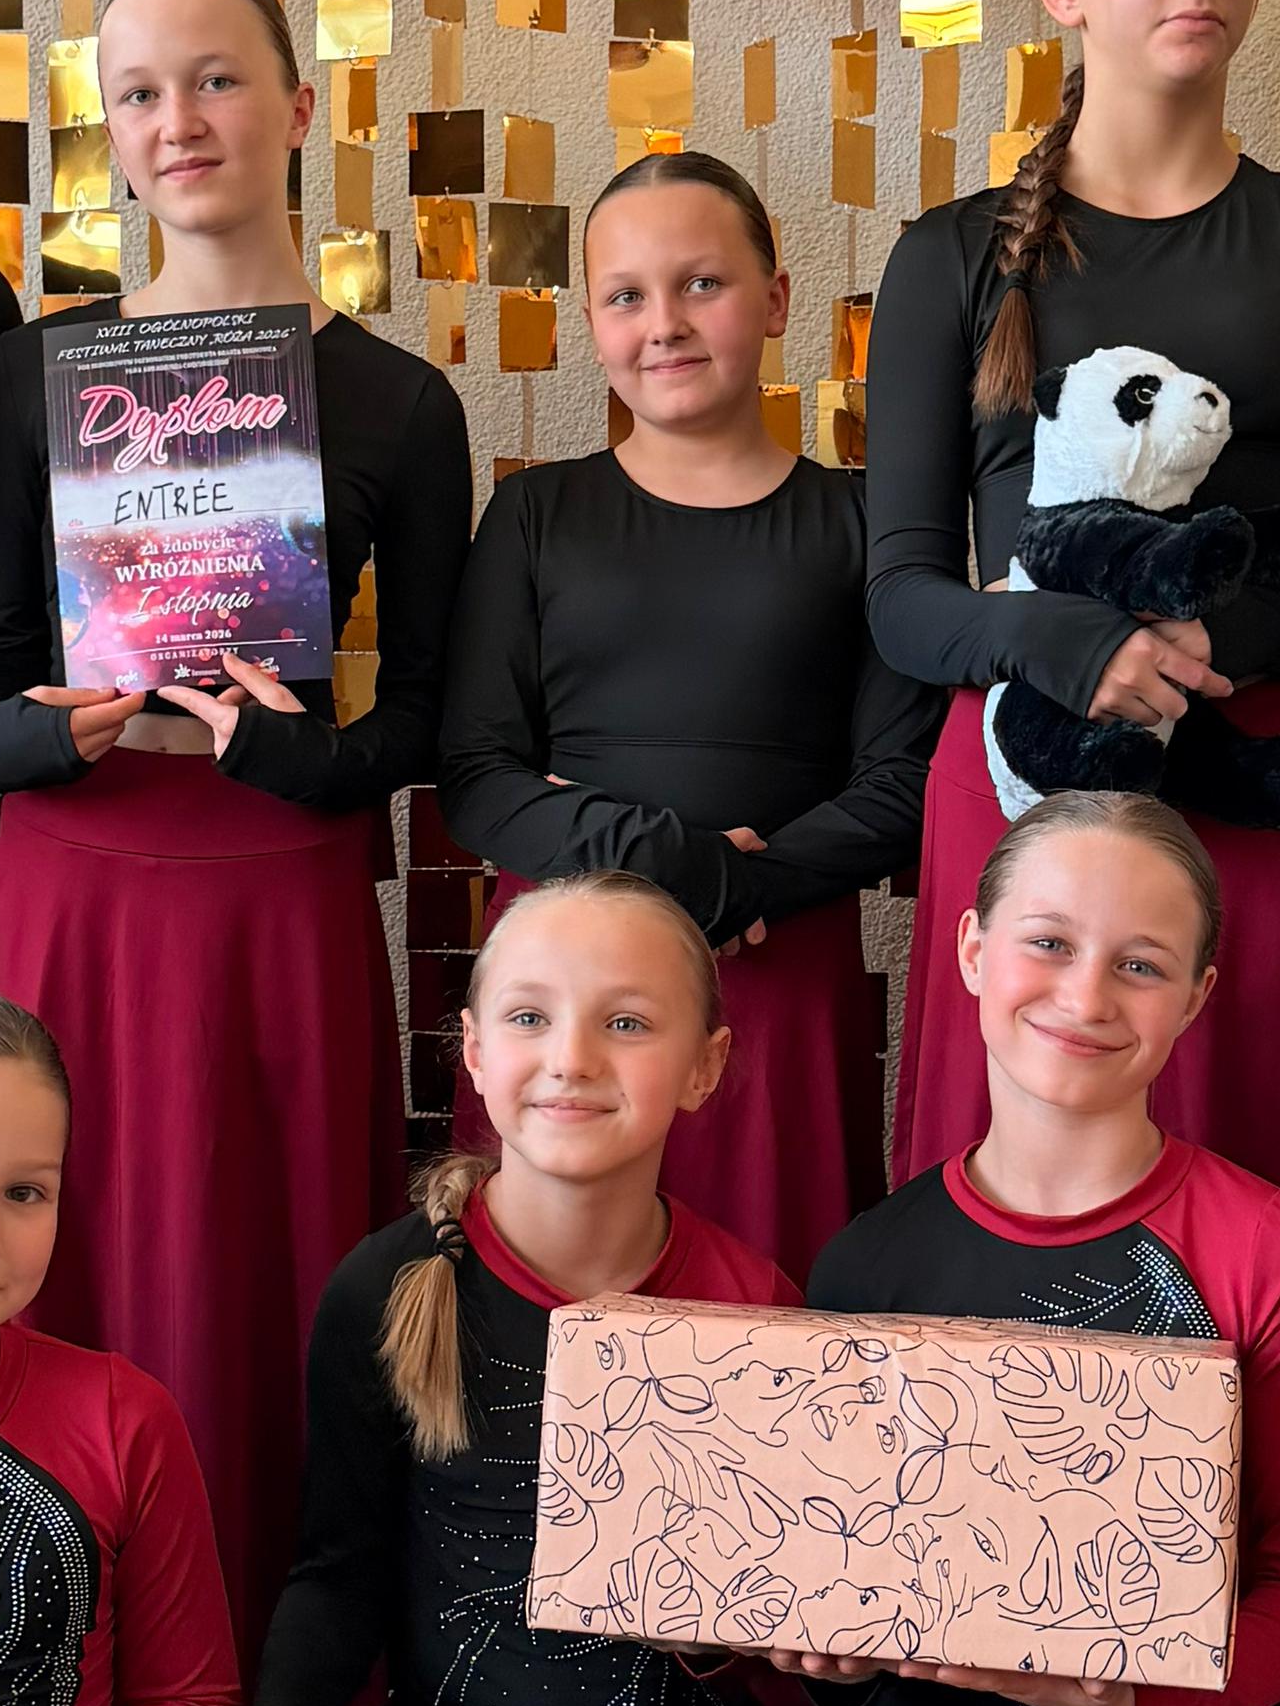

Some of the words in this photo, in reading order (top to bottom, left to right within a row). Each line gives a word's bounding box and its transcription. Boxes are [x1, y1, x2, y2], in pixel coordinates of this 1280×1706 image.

[96, 323, 135, 340] XVIII
[138, 313, 257, 336] OGÓLNOPOLSKI
[57, 341, 130, 362] FESTIWAL
[133, 334, 209, 354] TANECZNY
[79, 374, 288, 473] Dyplom
[114, 554, 266, 583] WYRÓŻNIENIA
